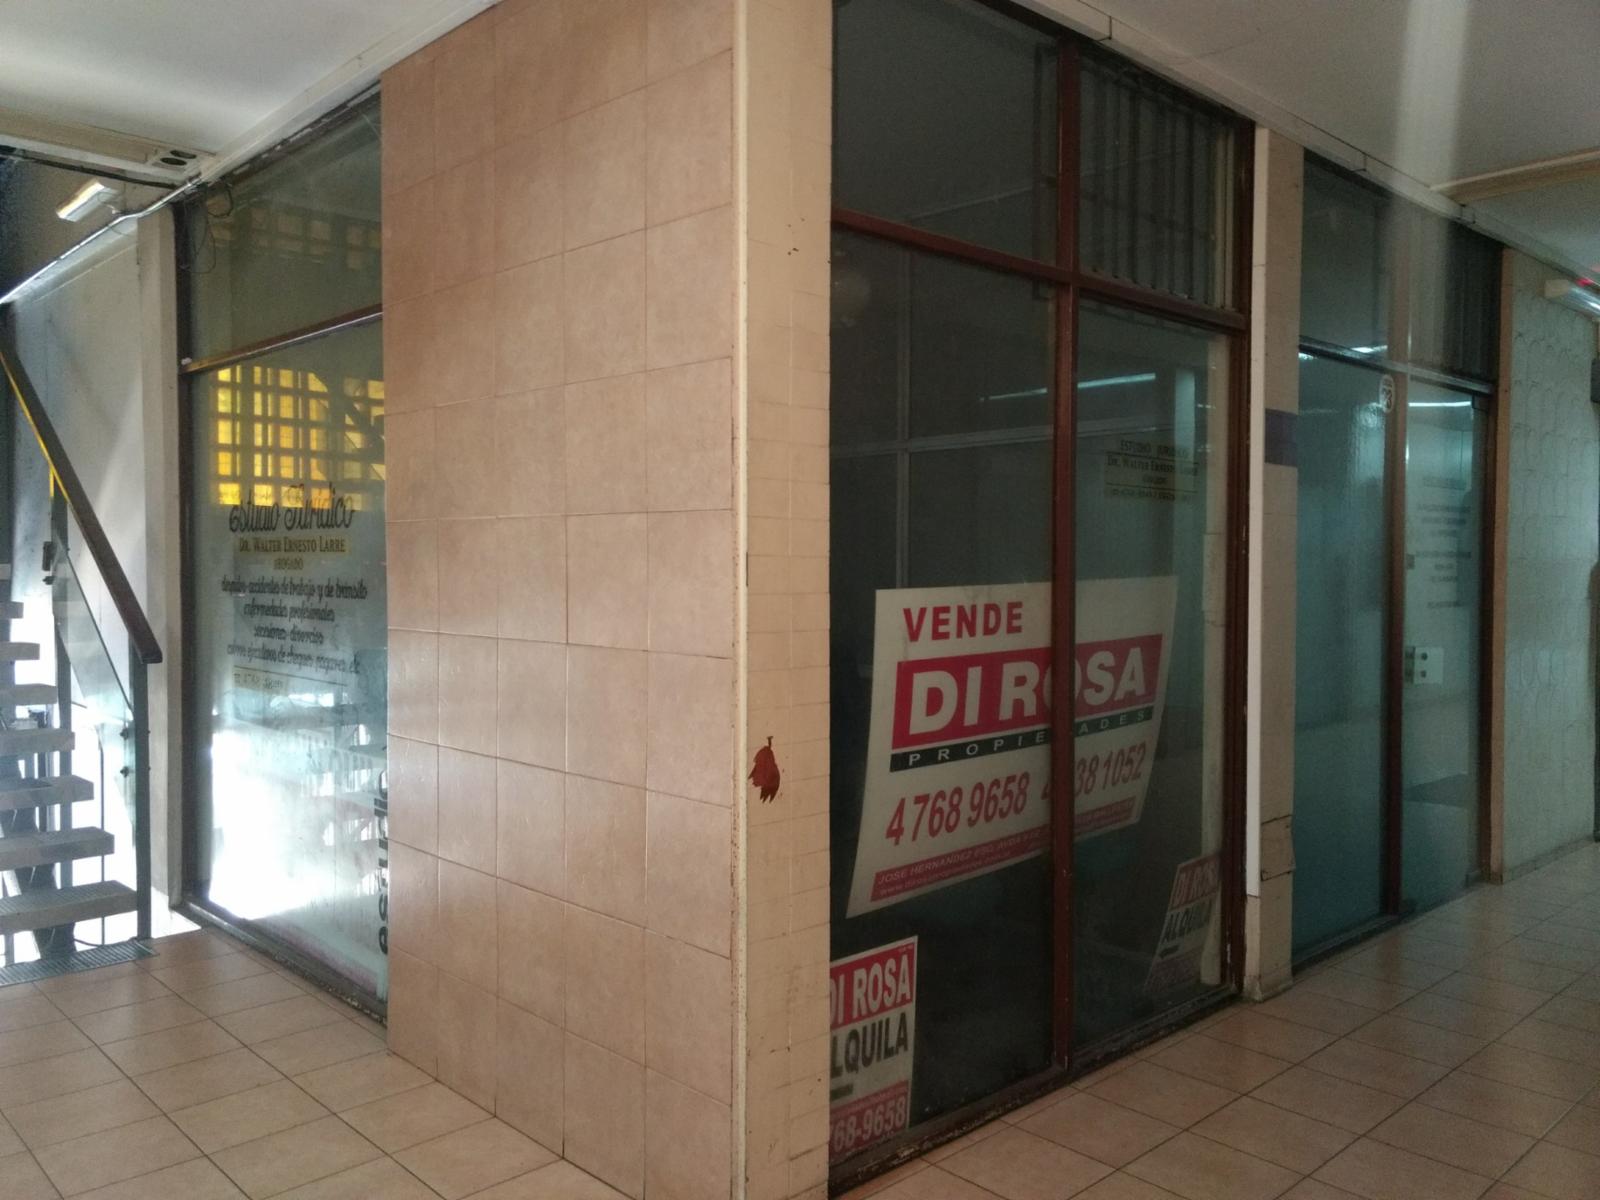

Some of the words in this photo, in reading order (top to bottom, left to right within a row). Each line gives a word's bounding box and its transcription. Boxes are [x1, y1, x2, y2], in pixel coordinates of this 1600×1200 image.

[284, 536, 317, 553] ERNESTO
[903, 601, 1024, 643] VENDE
[909, 665, 983, 736] DI
[908, 709, 1146, 767] PROPIEADES
[885, 786, 963, 847] 4768
[967, 771, 1030, 828] 9658
[852, 954, 911, 1019] ROSA
[830, 1012, 908, 1080] LQUILA
[830, 1095, 906, 1152] 68-9658
